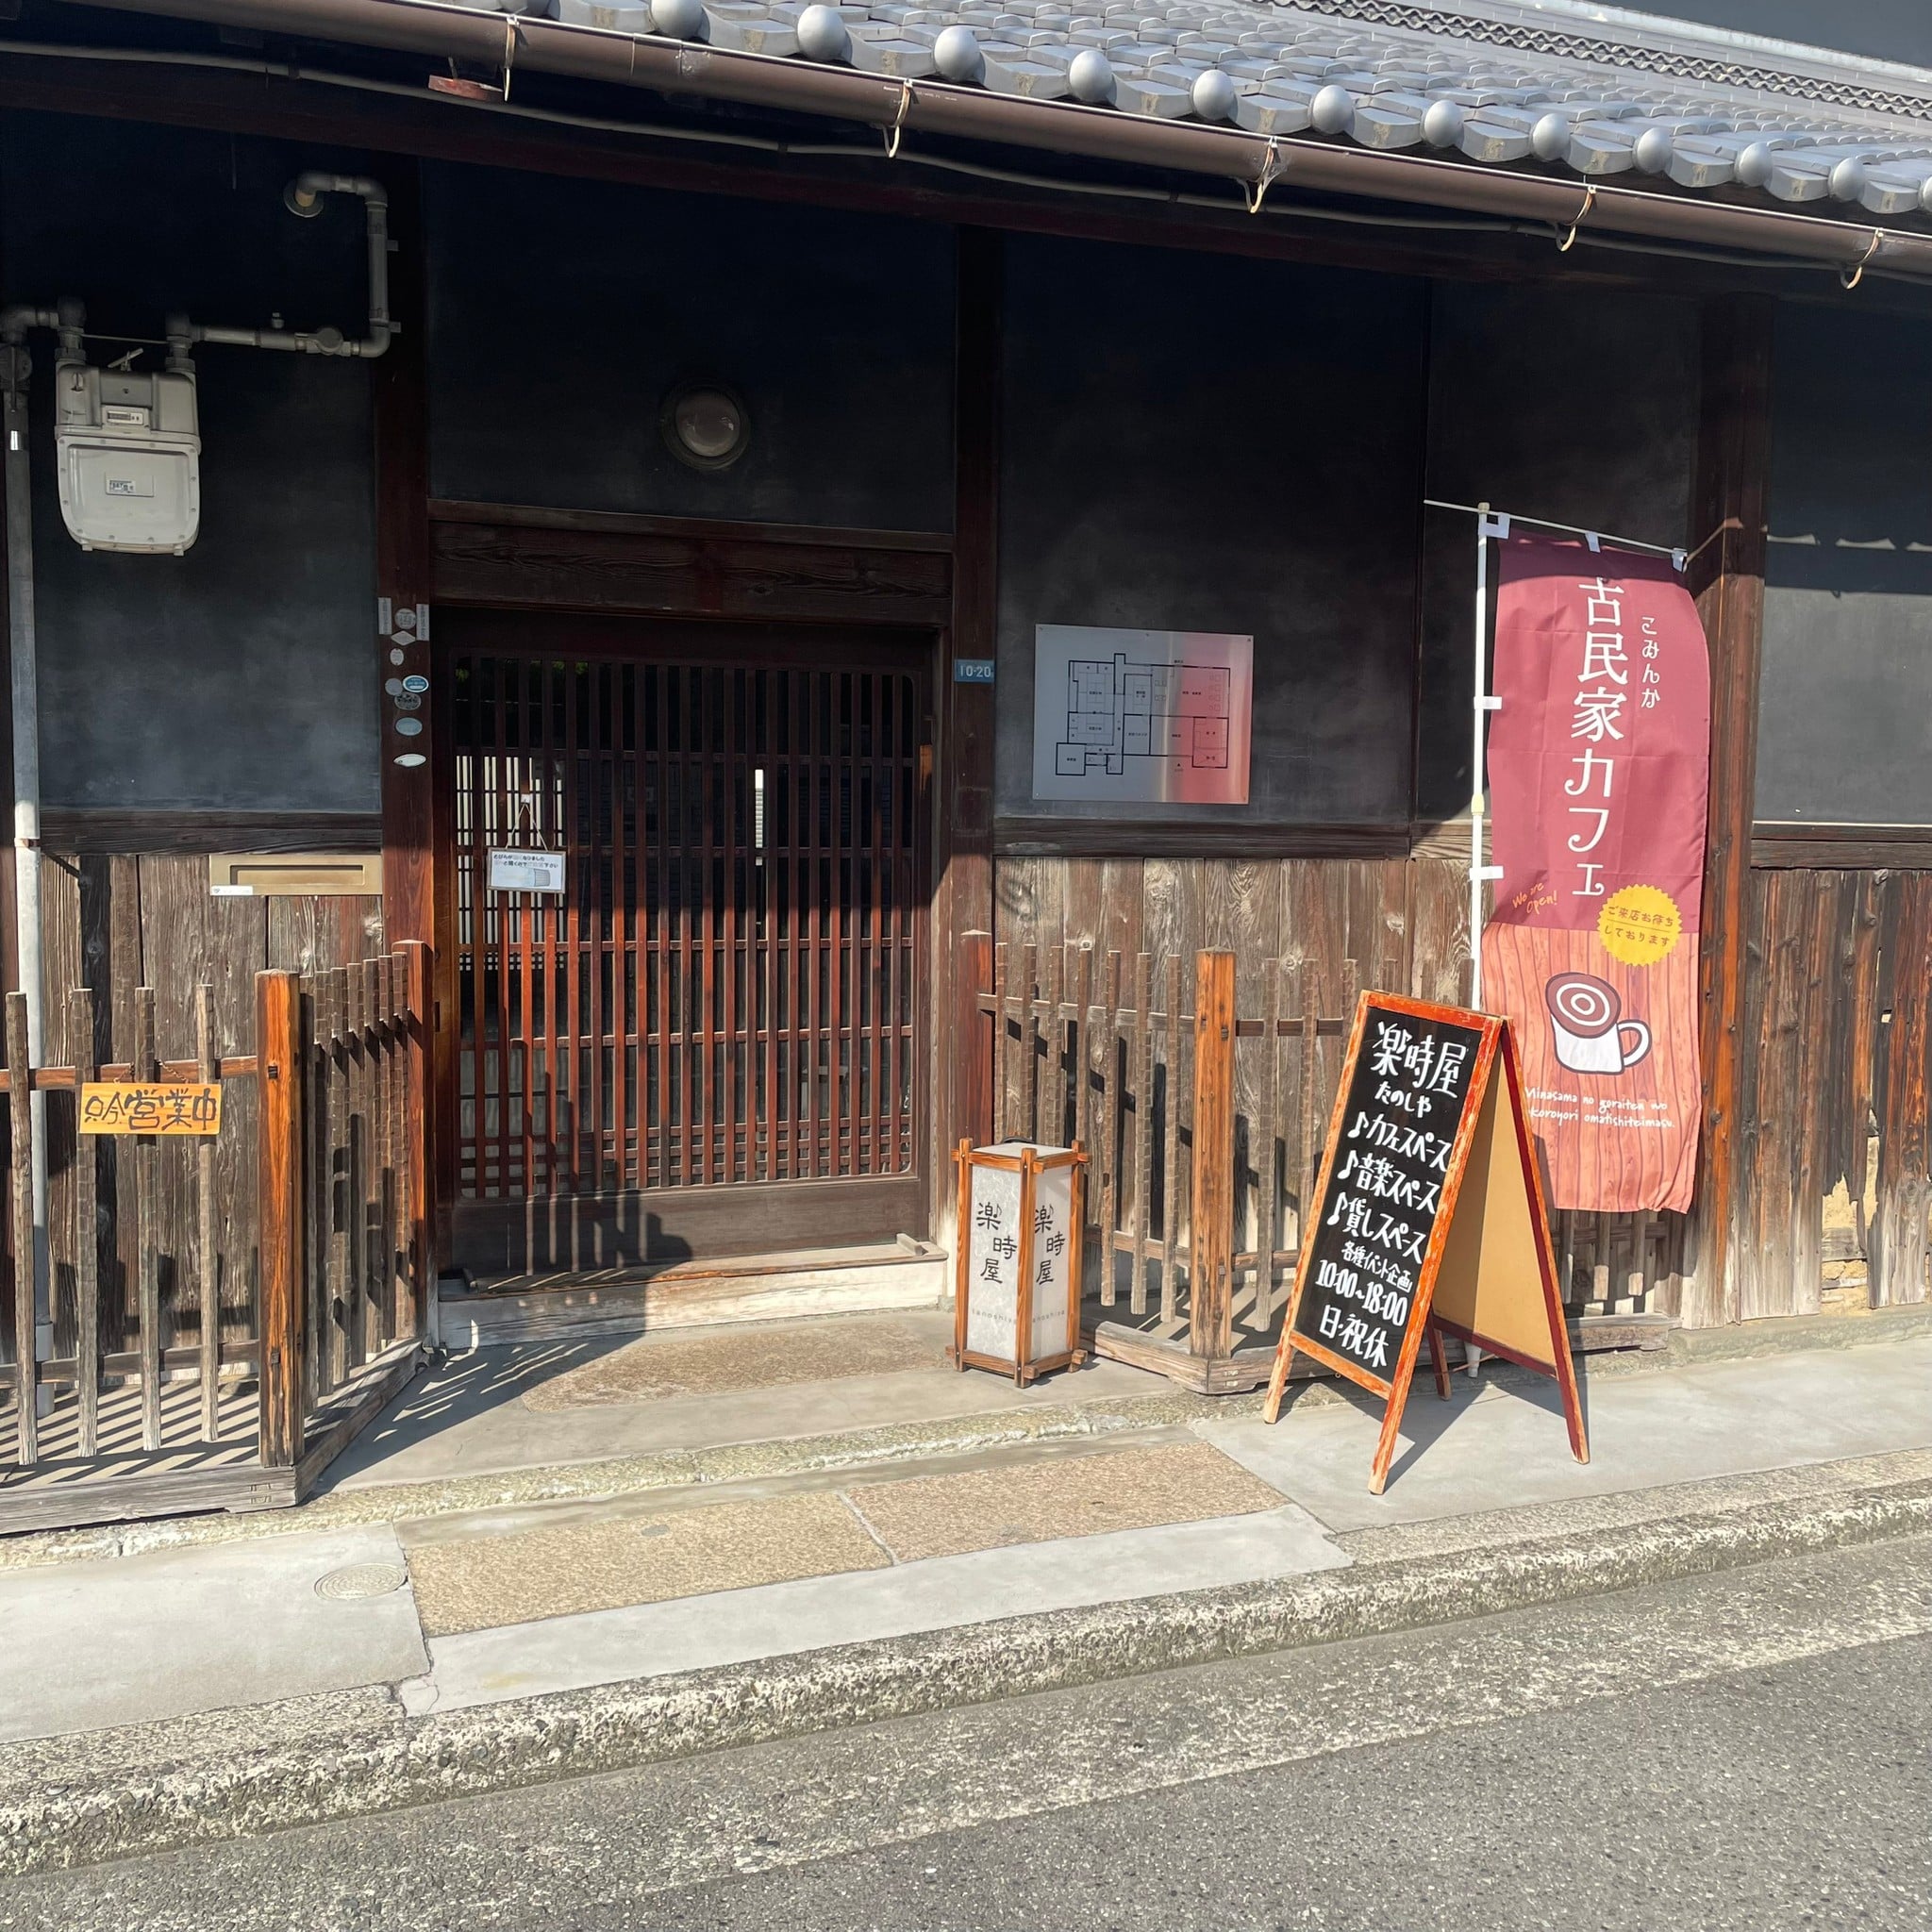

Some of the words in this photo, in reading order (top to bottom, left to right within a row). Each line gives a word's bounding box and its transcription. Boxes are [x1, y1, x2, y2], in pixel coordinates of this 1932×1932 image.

[959, 664, 991, 678] 10-20
[1640, 617, 1660, 708] こみんか
[1564, 576, 1629, 896] 古民家カフェ
[1604, 924, 1670, 947] しております
[1607, 905, 1674, 927] ご来店お待ち
[1370, 1021, 1467, 1098] 楽時屋
[1374, 1081, 1432, 1118] たのしや
[1528, 1106, 1579, 1126] koroyori
[1583, 1095, 1594, 1106] no
[1366, 1113, 1453, 1172] カフェスペース
[1357, 1152, 1441, 1214] 音楽スペース
[975, 1202, 1018, 1285] 楽時屋
[1034, 1203, 1066, 1286] 楽時屋
[1341, 1241, 1413, 1293] 各種イベント企画
